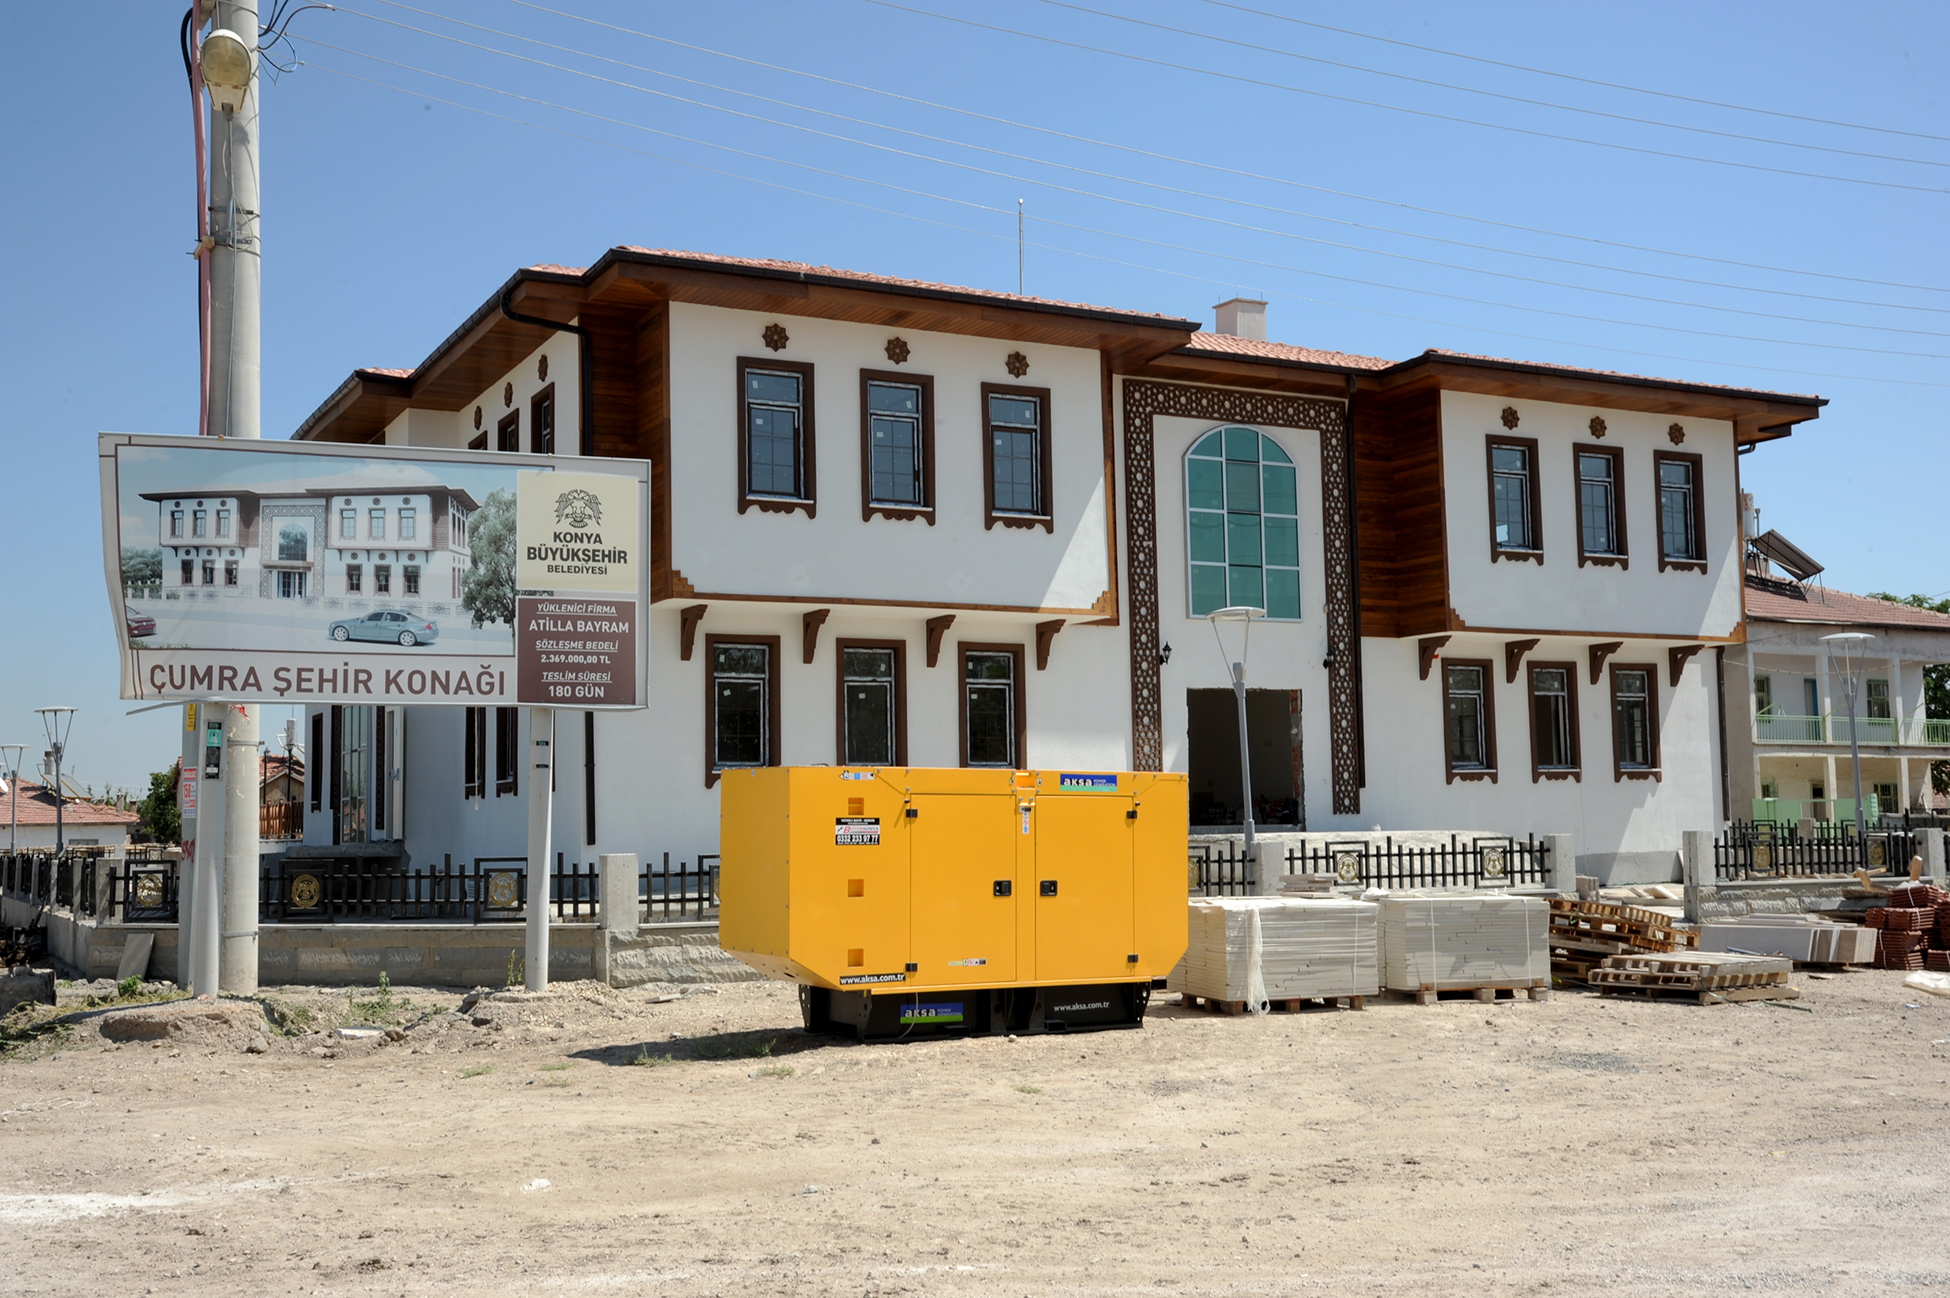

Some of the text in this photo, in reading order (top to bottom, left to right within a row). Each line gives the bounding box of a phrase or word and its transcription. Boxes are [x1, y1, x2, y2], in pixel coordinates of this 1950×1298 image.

[553, 531, 603, 544] KONYA
[527, 543, 628, 564] BÜYÜKŞEHİR
[547, 563, 607, 575] BELEDİYESİ
[537, 602, 617, 614] YÜKLENİCİ FİRMA
[529, 617, 629, 633] ATİLLA BAYRAM
[535, 638, 619, 650] SÖZLEŞME BEDELİ
[540, 654, 611, 664] 2.369.000,00 TL
[150, 661, 505, 697] ÇUMRA ŞEHİR KONAĞI
[542, 670, 611, 681] TESLİM SÜRESİ
[548, 683, 605, 698] 180 GÜN
[1063, 778, 1092, 786] aksa
[840, 974, 905, 984] www.aksa.com.tr
[1053, 1001, 1110, 1011] www.aksa.com.tr
[904, 1008, 936, 1017] aksa
